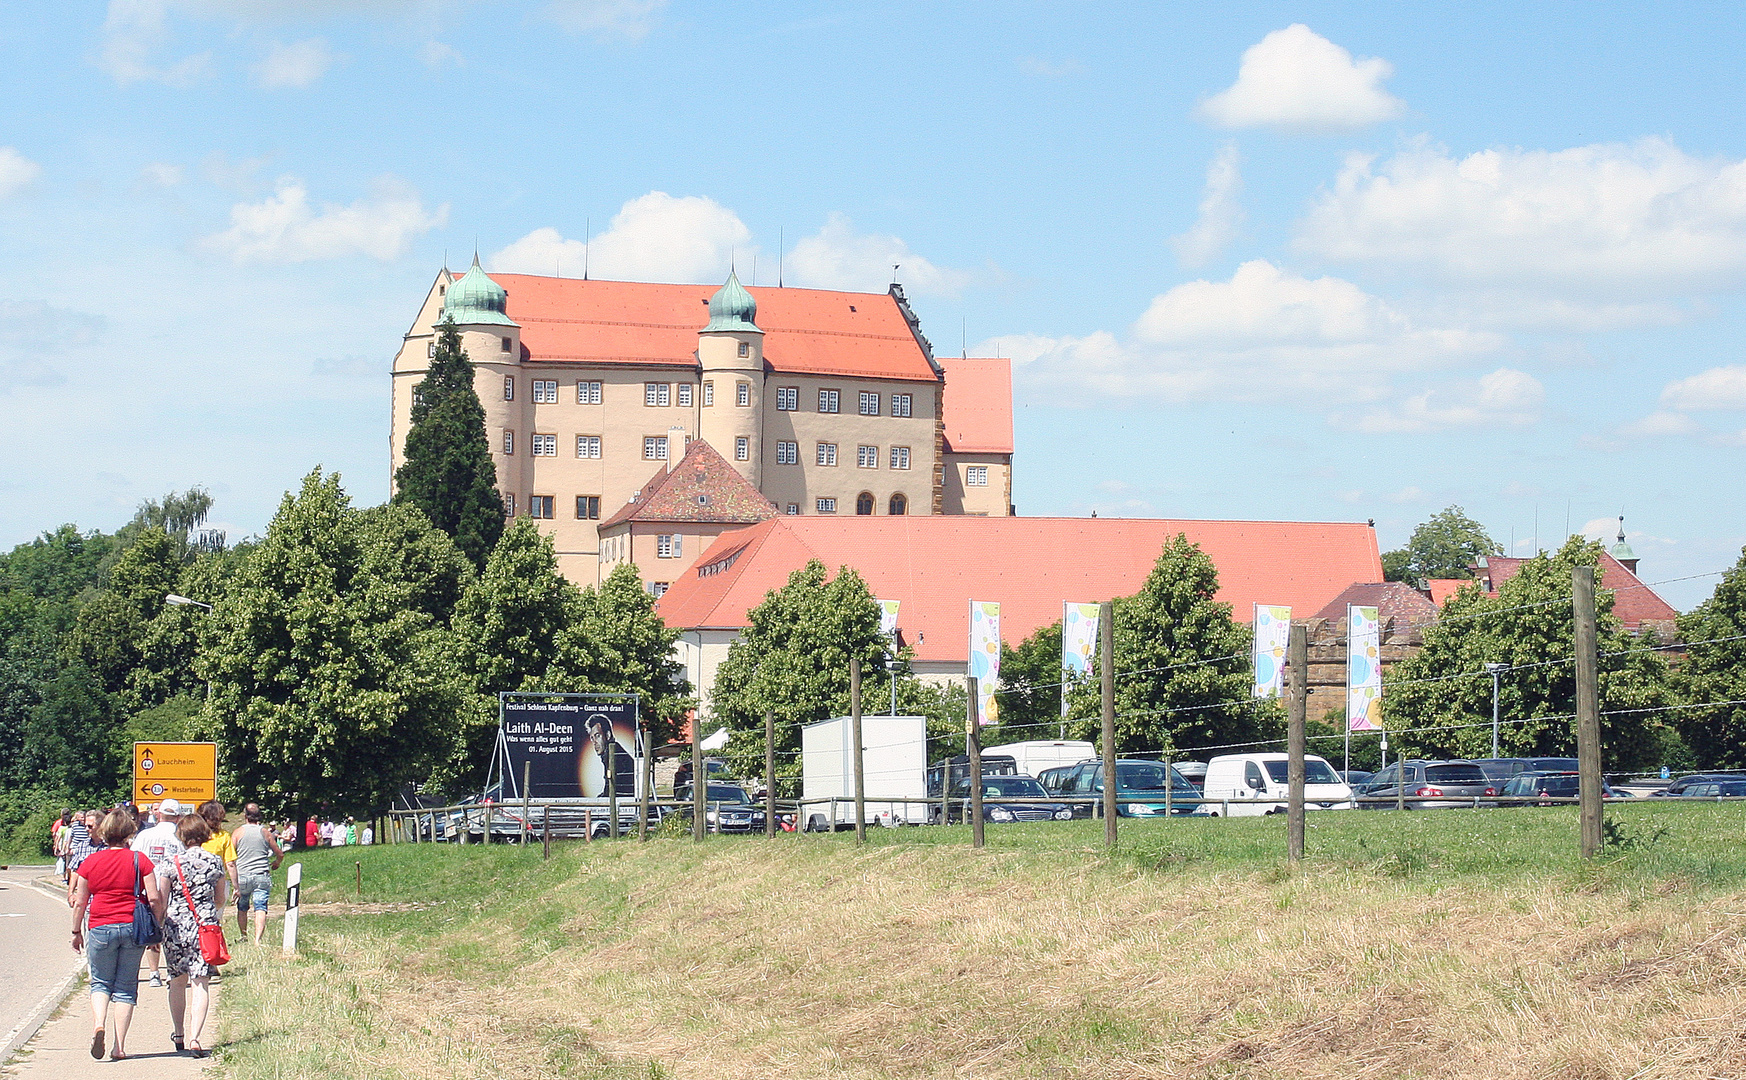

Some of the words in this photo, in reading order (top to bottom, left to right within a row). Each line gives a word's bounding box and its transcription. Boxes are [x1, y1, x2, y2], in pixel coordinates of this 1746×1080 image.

[548, 704, 579, 713] Kapfenburg
[598, 704, 608, 712] nah
[609, 704, 624, 712] dran!
[506, 722, 531, 734] Laith
[534, 722, 573, 734] Al-Deen
[549, 736, 559, 744] gut
[560, 736, 573, 744] geht
[539, 746, 558, 754] August
